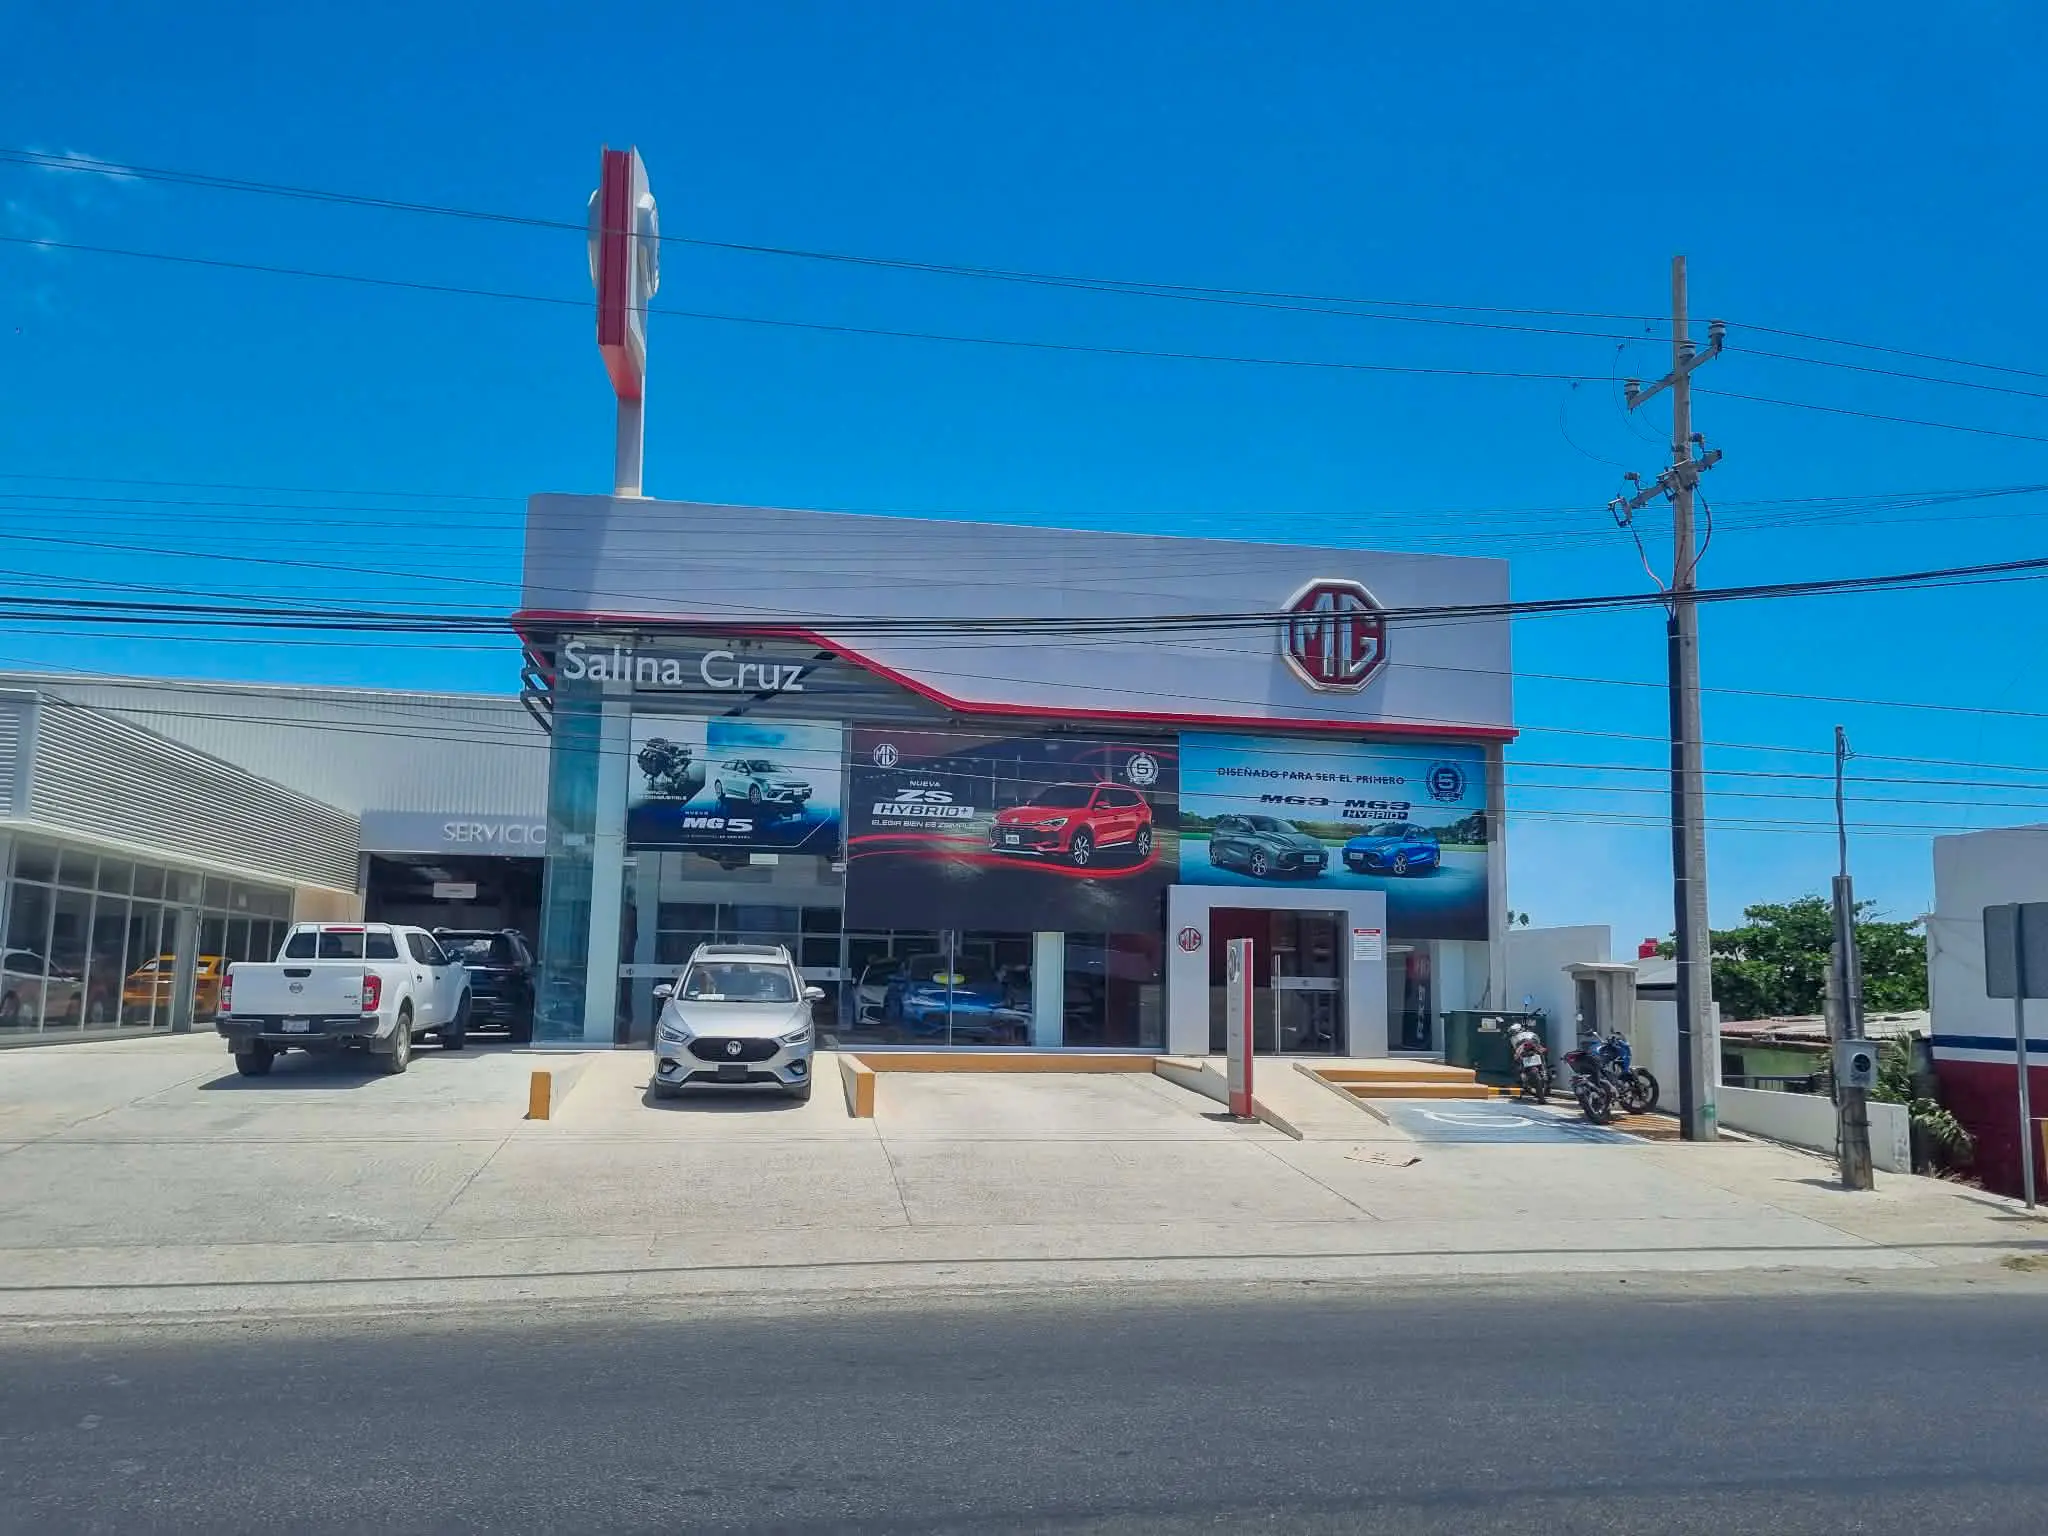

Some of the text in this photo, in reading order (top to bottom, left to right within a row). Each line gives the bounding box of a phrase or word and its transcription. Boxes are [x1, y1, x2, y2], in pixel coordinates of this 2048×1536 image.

[1292, 591, 1379, 678] MG
[563, 641, 804, 691] Salina Cruz
[875, 745, 897, 766] MG
[1217, 767, 1404, 785] DISEÑADO PARA SER EL PRIMERO
[895, 789, 953, 803] ZS
[1260, 794, 1329, 806] MG3
[880, 804, 969, 817] HYBRID+
[1345, 800, 1410, 810] MG3
[1346, 811, 1408, 820] HYBRID+
[682, 817, 753, 832] MG 5
[441, 822, 547, 844] SERVICIO
